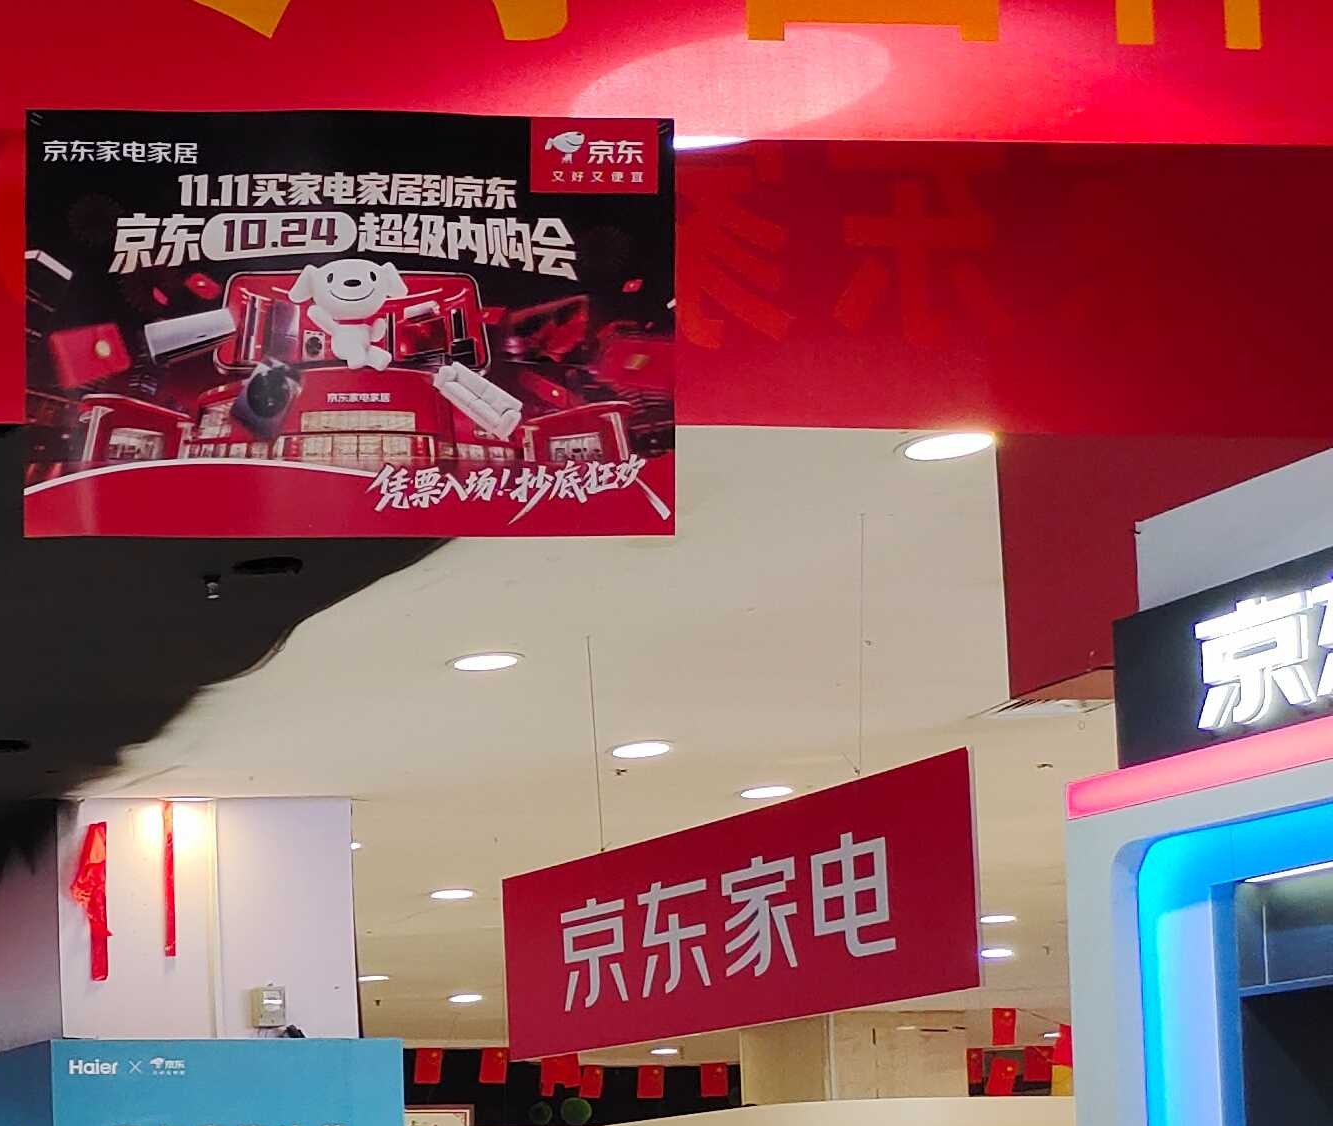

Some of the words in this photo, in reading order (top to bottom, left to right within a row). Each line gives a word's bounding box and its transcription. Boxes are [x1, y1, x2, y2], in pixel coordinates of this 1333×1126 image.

[43, 139, 199, 166] 京东家电家居
[588, 138, 644, 166] 京东
[551, 169, 645, 185] 又好又便宜
[176, 172, 518, 212] 11.11买家电家居到京东
[367, 453, 672, 523] 凭票入场!抄底狂欢
[561, 831, 898, 1012] 京东家电
[68, 1058, 118, 1076] Haier
